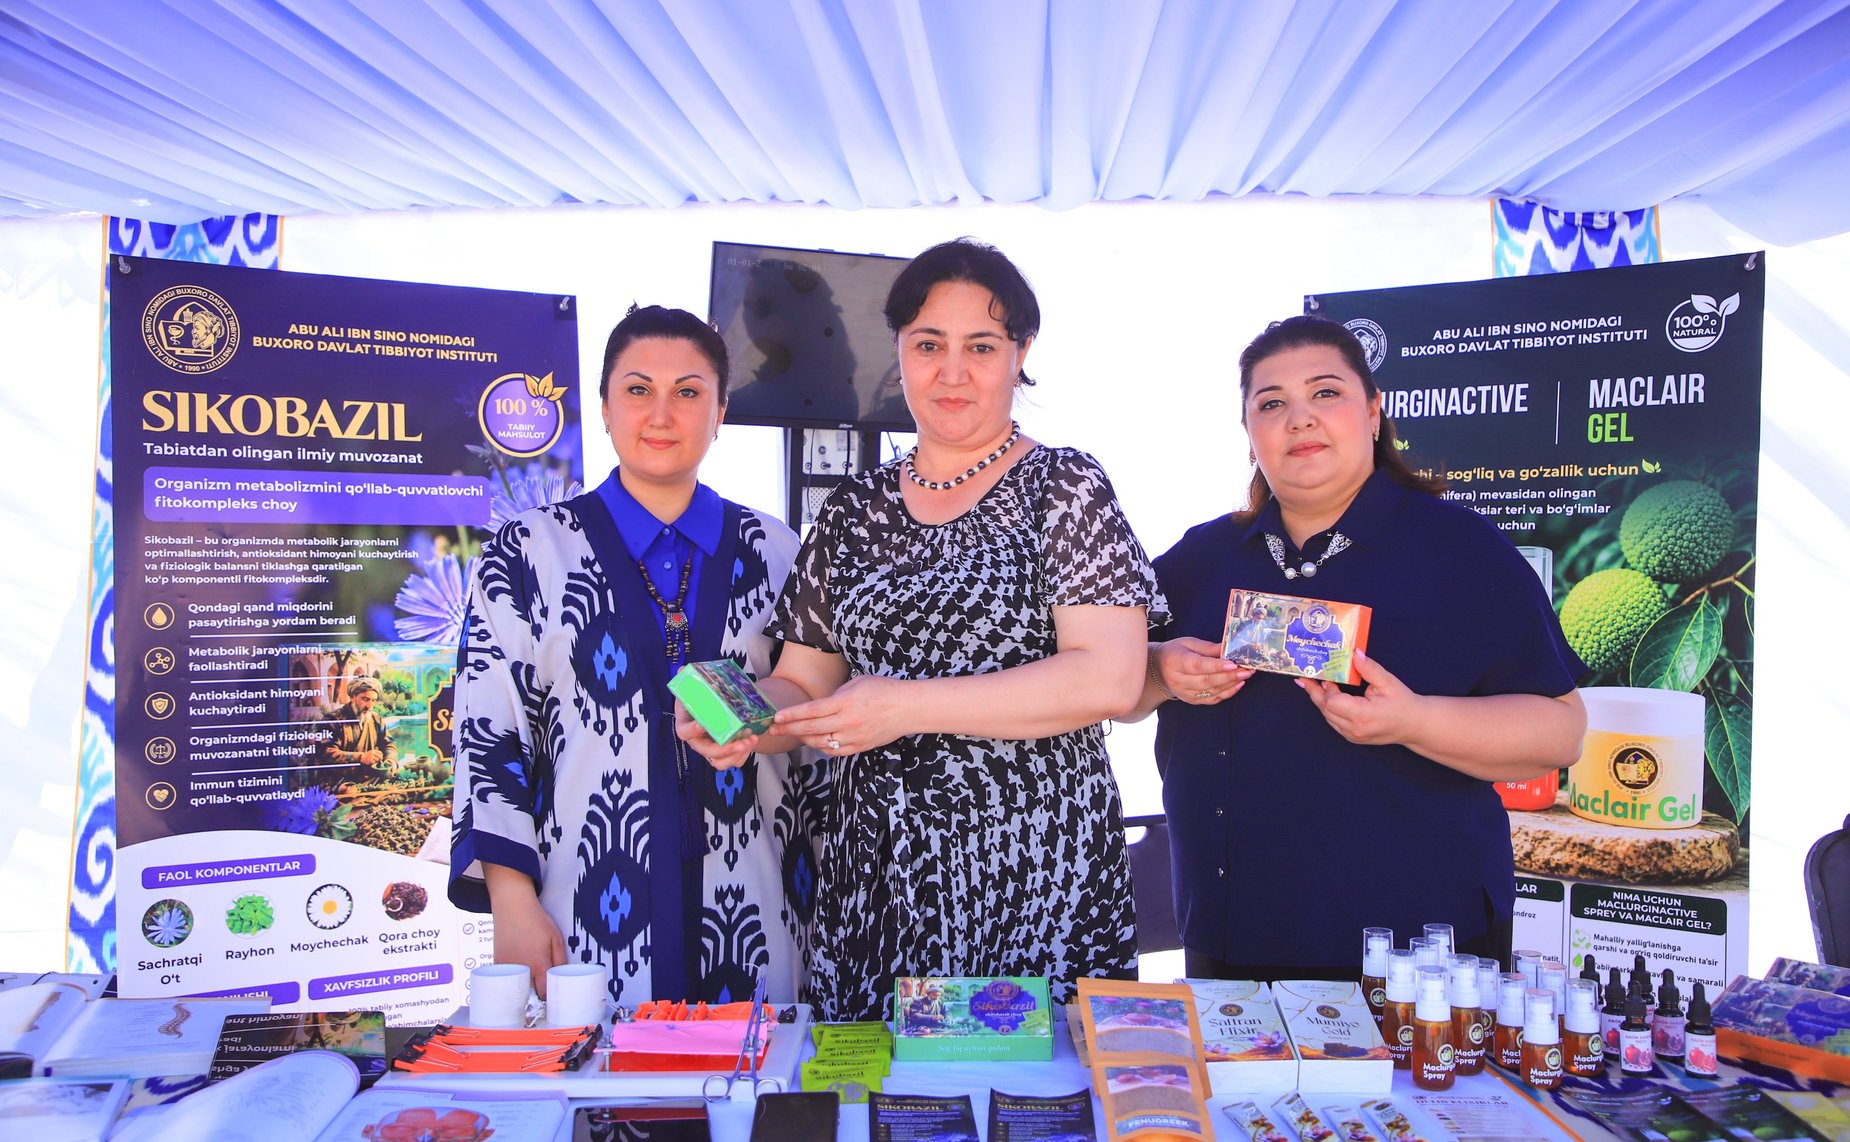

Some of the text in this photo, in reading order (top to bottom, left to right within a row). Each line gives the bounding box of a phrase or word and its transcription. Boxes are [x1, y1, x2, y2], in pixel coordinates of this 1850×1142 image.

[147, 290, 176, 317] NOMIDAGI
[176, 287, 208, 298] BUXORO
[208, 294, 231, 316] DAVLAT
[288, 323, 475, 347] ABU ALI IBN SINO NOMIDAGI
[1433, 316, 1622, 341] ABU ALI IBN SINO NOMIDAGI
[1672, 327, 1717, 337] NATURAL
[252, 336, 498, 363] BUXORO DAVLAT TIBBIYOT INSTITUTI
[1401, 329, 1647, 357] BUXORO DAVLAT TIBBIYOT INSTITUTI
[1589, 373, 1705, 409] MACLAIR
[494, 398, 549, 417] 100 %
[1381, 383, 1529, 419] URGINACTIVE
[142, 390, 423, 442] SIKOBAZIL
[507, 423, 536, 431] TABIIY
[1587, 412, 1634, 444] GEL
[498, 431, 546, 439] MAHSULOT
[143, 442, 423, 464] Tabiatdan olingan ilmiy muvozanat
[1446, 467, 1495, 482] sog‘liq
[1498, 469, 1516, 479] va
[1519, 464, 1583, 482] go‘zallik
[1588, 463, 1639, 477] uchun
[154, 478, 484, 497] Organizm metabolizmini qo‘llab-quvvatlovchi
[1480, 487, 1596, 501] mevasidan olingan
[154, 496, 298, 513] fitokompleks choy
[1505, 505, 1526, 515] teri
[1529, 506, 1543, 515] va
[1497, 520, 1536, 531] uchun
[144, 535, 399, 547] Sikobazil bu organizmda metabolik jarayonlarni
[144, 548, 419, 560] optimallashtirish, antioksidant himoyani kuchaytirish
[144, 562, 363, 572] va fiziologik balansni tiklashga qaratilgan
[144, 574, 330, 585] ko‘p komponentli fitokompleksdir.
[188, 601, 334, 615] Qondagi qand miqdorini
[188, 615, 357, 631] pasaytirishga yordam beradi
[188, 644, 322, 658] Metabolik jarayonlarni
[188, 659, 268, 672] faollashtiradi
[188, 686, 324, 702] Antioksidant himoyani
[189, 703, 266, 717] kuchaytiradi
[433, 708, 454, 731] Si
[189, 729, 334, 747] Organizmdagi fiziologik
[189, 744, 316, 761] muvozanatni tiklaydi
[190, 776, 283, 791] Immun tizimini
[1517, 782, 1527, 790] ml
[190, 789, 306, 807] qo‘llab-quvvatlaydi
[1658, 793, 1696, 822] Gel
[158, 859, 301, 882] FAOL KOMPONENTLAR
[1515, 882, 1537, 894] LAR
[1612, 891, 1682, 907] NIMA UCHUN
[1597, 898, 1698, 919] MACLURGINACTIVE
[1583, 907, 1712, 931] SPREY VA MACLAIR GEL?
[378, 927, 441, 945] Qora choy
[1593, 933, 1625, 945] Mahalliy
[289, 934, 369, 954] Moychechak
[382, 940, 438, 955] ekstrakti
[224, 944, 275, 961] Rayhon
[1593, 944, 1618, 955] qarshi
[1653, 952, 1696, 966] qoldiruvchi
[137, 952, 203, 973] Sachratqi
[160, 973, 181, 986] O‘t
[323, 970, 440, 994] XAVFSIZLIK PROFILI
[1687, 977, 1724, 988] samarali
[394, 997, 450, 1009] xomashyodan
[1208, 1018, 1262, 1027] Saffran
[1306, 1016, 1360, 1028] Mumiyo
[1321, 1026, 1352, 1036] Gold
[1502, 1048, 1521, 1057] Macl
[1502, 1056, 1521, 1064] Spra
[1455, 1056, 1477, 1065] Spray
[1574, 1062, 1596, 1071] Spray
[1423, 1071, 1446, 1080] Spray
[1530, 1076, 1553, 1086] Spray
[1128, 1116, 1189, 1128] FENUGREEK
